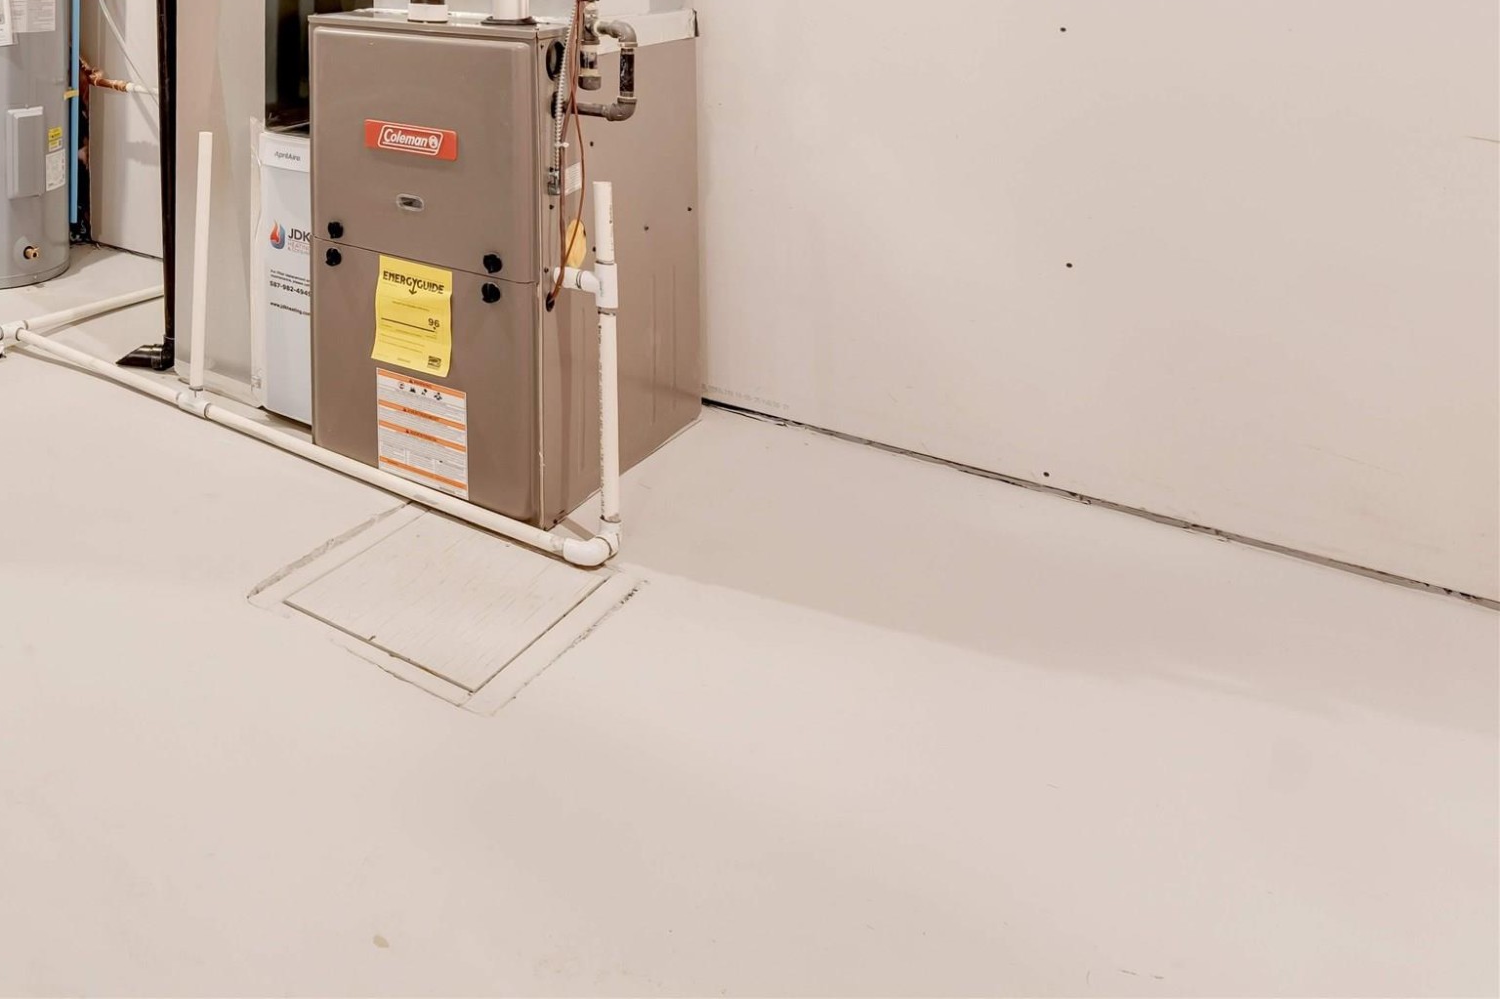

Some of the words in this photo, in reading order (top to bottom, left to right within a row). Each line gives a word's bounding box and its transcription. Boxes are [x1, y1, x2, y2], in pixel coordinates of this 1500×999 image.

[383, 128, 428, 148] Coleman
[288, 228, 311, 242] JDK
[382, 270, 445, 295] ENERGYGUIDE
[427, 317, 441, 328] 96
